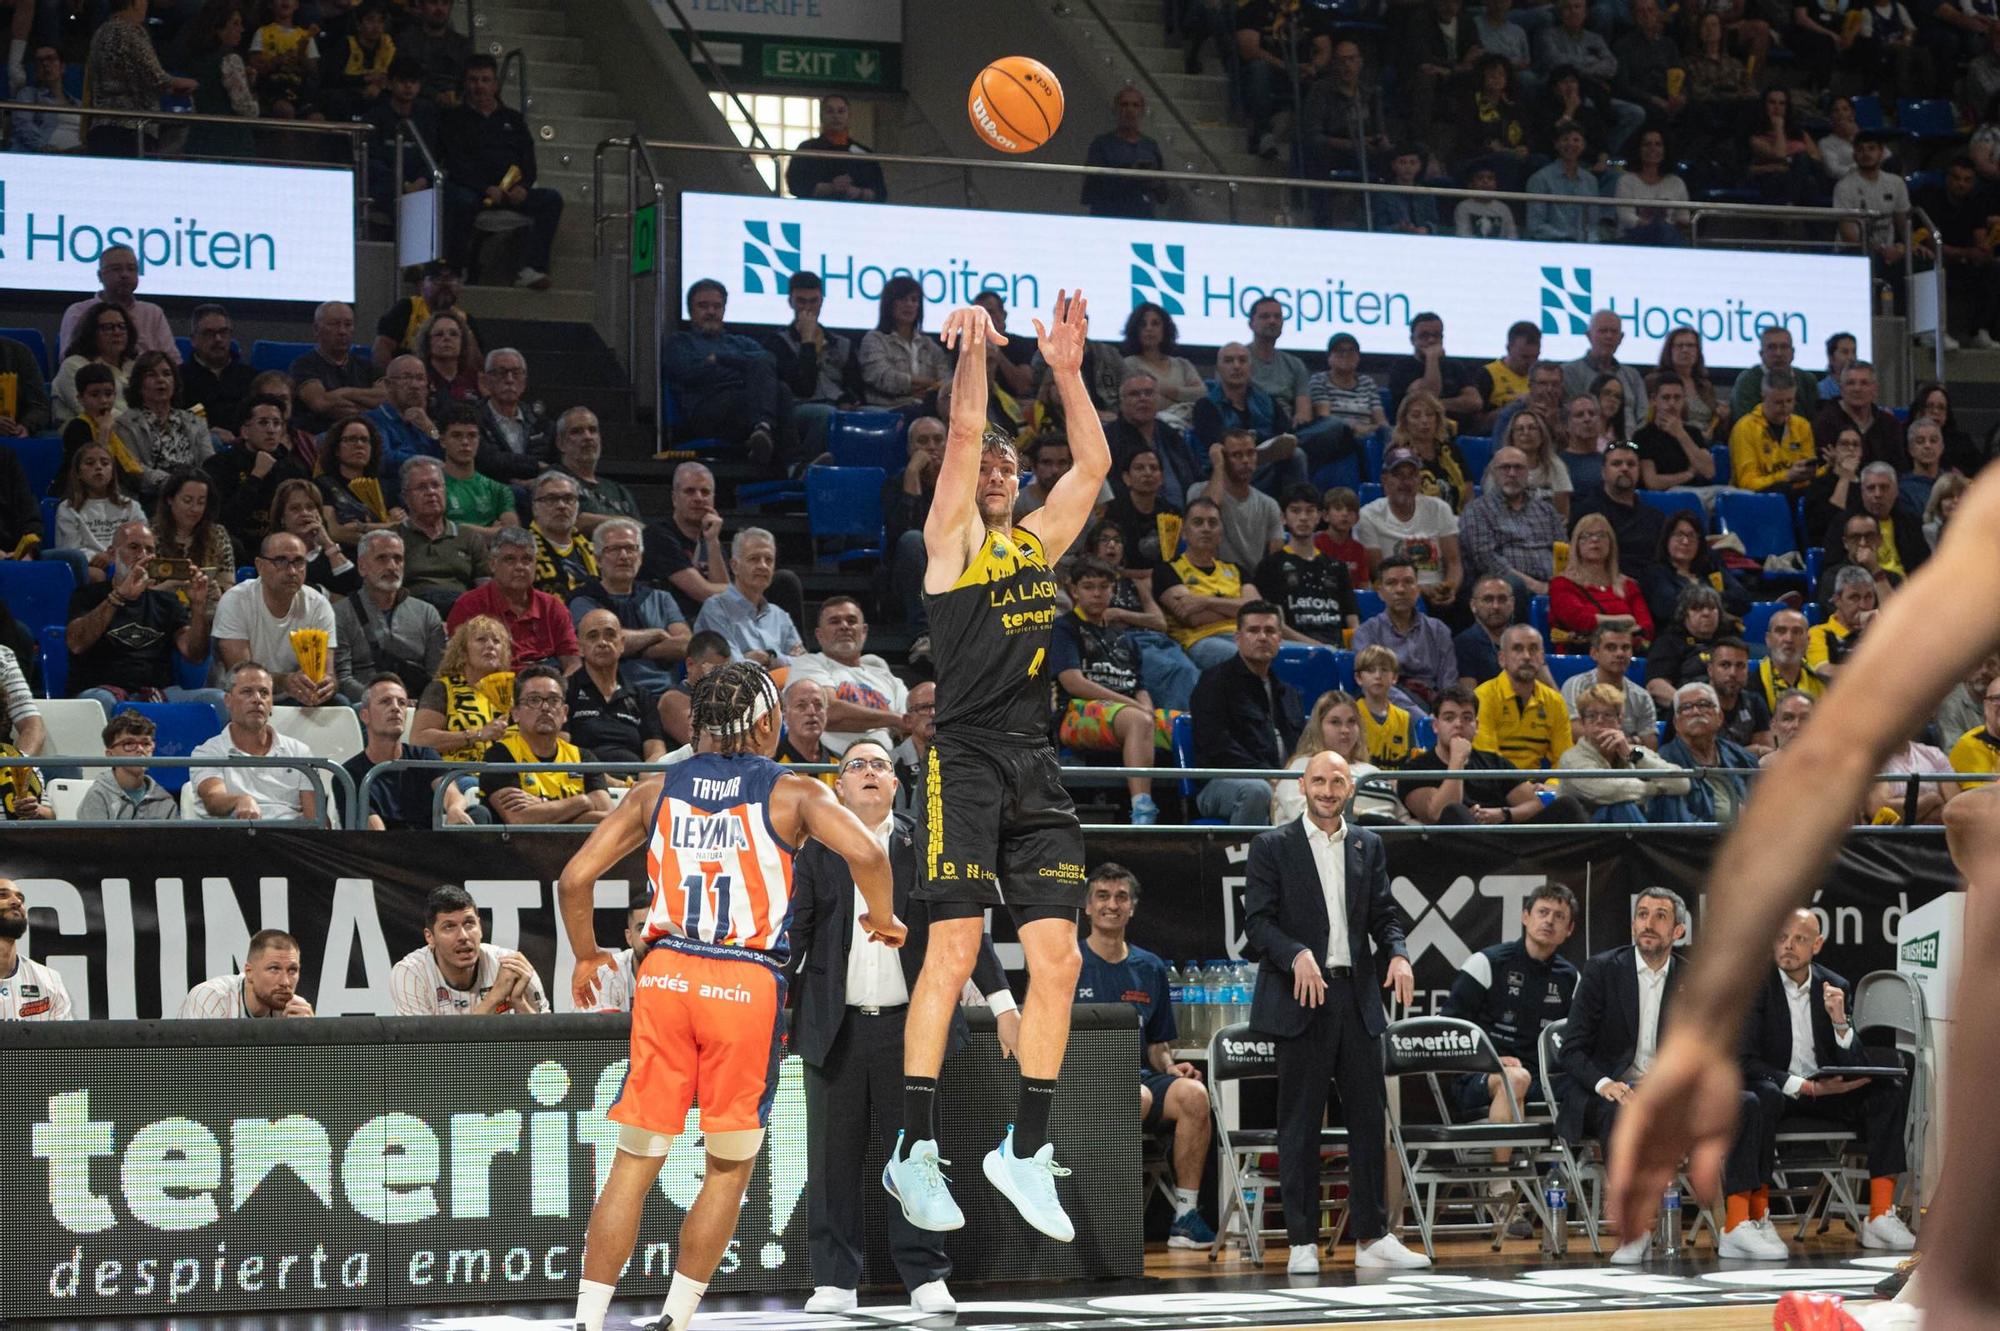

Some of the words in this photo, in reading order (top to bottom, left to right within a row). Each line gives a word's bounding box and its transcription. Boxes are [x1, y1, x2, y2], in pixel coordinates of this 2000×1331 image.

[777, 51, 835, 74] EXIT
[973, 96, 1018, 149] Wilson
[821, 254, 1038, 308] Hopiten
[1203, 275, 1410, 331] Hospiten
[990, 588, 1016, 607] LA
[1028, 647, 1045, 681] 4
[692, 776, 741, 800] TAYLOR
[672, 816, 746, 848] LEYMA
[696, 850, 723, 859] NATURA
[1058, 862, 1079, 871] Islas
[1039, 867, 1079, 879] Canarias
[683, 875, 731, 940] 11
[638, 973, 689, 992] Nordés
[699, 984, 750, 1003] ancín
[1391, 1029, 1481, 1055] tenerife!
[50, 1241, 370, 1303] despierta
[409, 1240, 741, 1285] emocns
